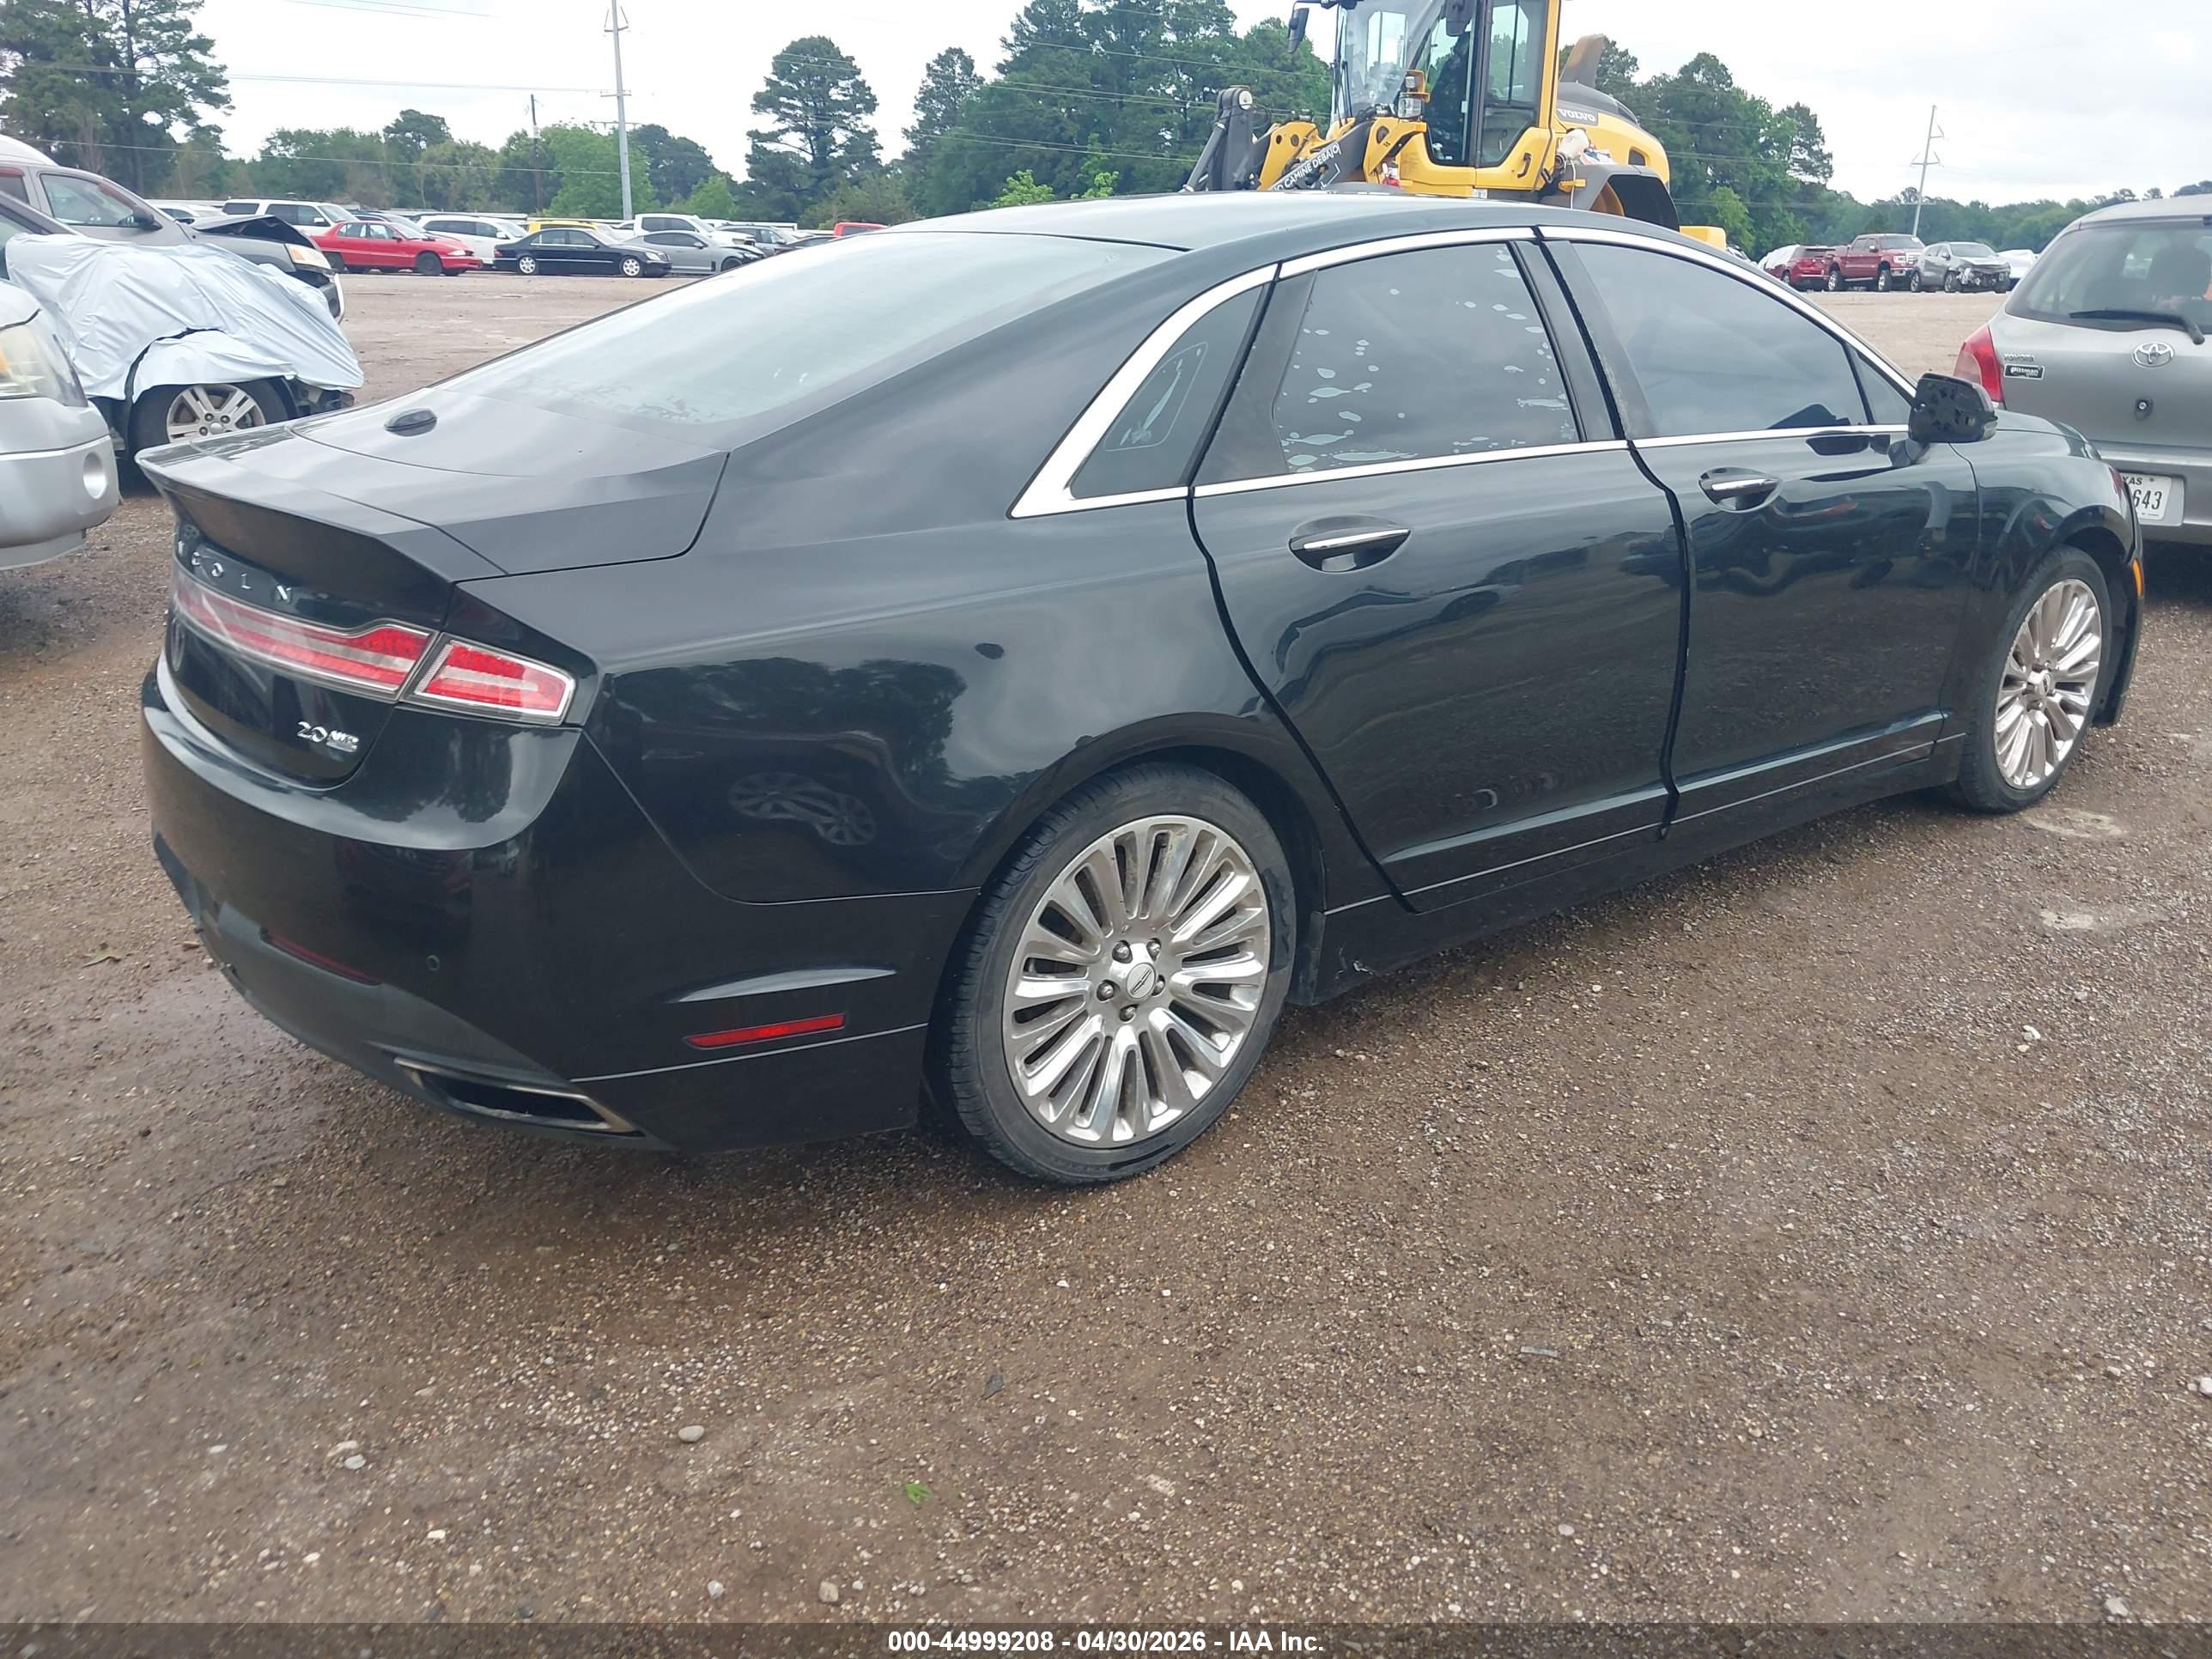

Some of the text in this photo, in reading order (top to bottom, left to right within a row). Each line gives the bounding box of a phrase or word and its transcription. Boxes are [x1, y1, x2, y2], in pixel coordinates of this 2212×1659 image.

[1556, 108, 1596, 122] VOLVO
[1285, 163, 1312, 187] CAMINE
[1312, 143, 1339, 167] DEBAJO
[2133, 489, 2162, 510] 643
